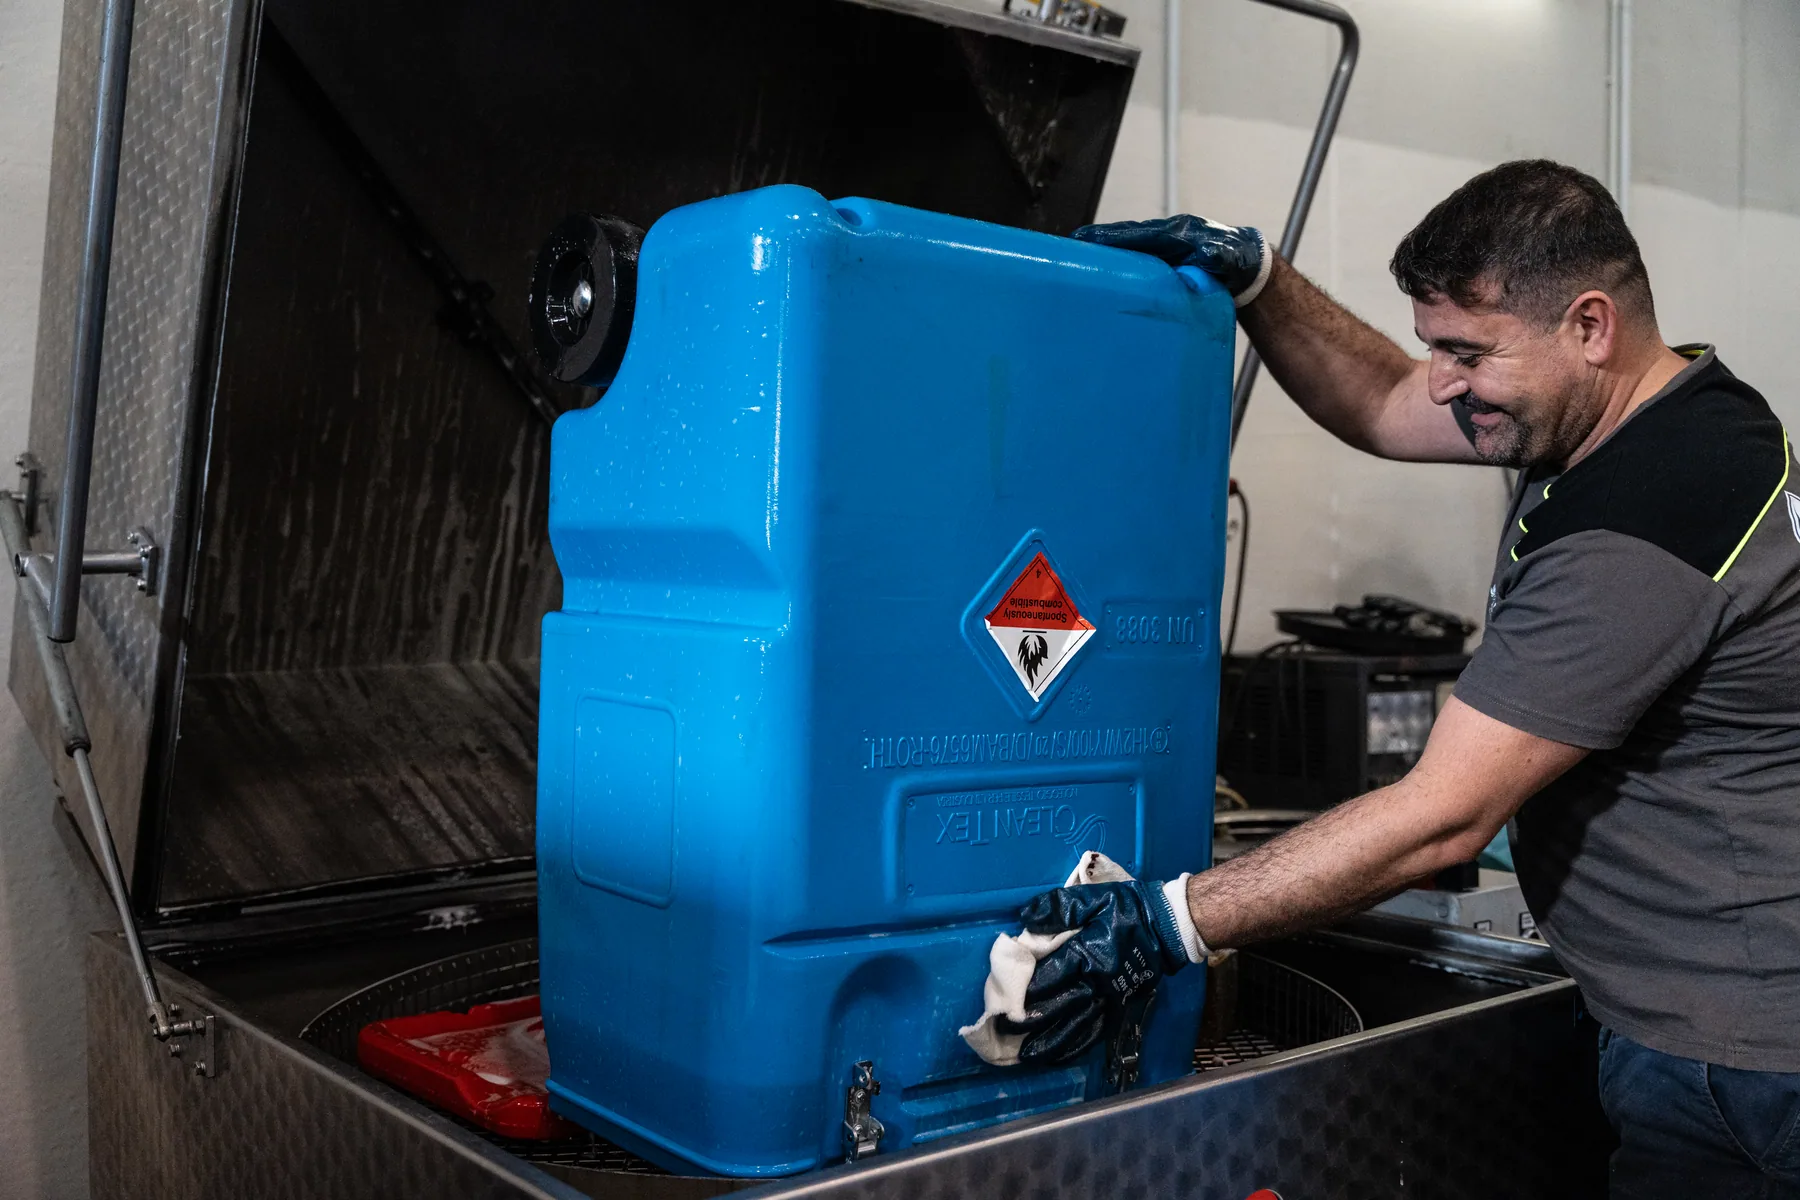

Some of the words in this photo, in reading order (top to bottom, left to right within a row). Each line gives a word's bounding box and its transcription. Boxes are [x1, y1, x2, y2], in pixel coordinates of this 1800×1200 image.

[1035, 568, 1042, 579] 4
[1009, 597, 1063, 609] combustible
[1003, 610, 1067, 623] Spontaneously
[1116, 615, 1160, 644] 3088
[1167, 616, 1194, 644] UN
